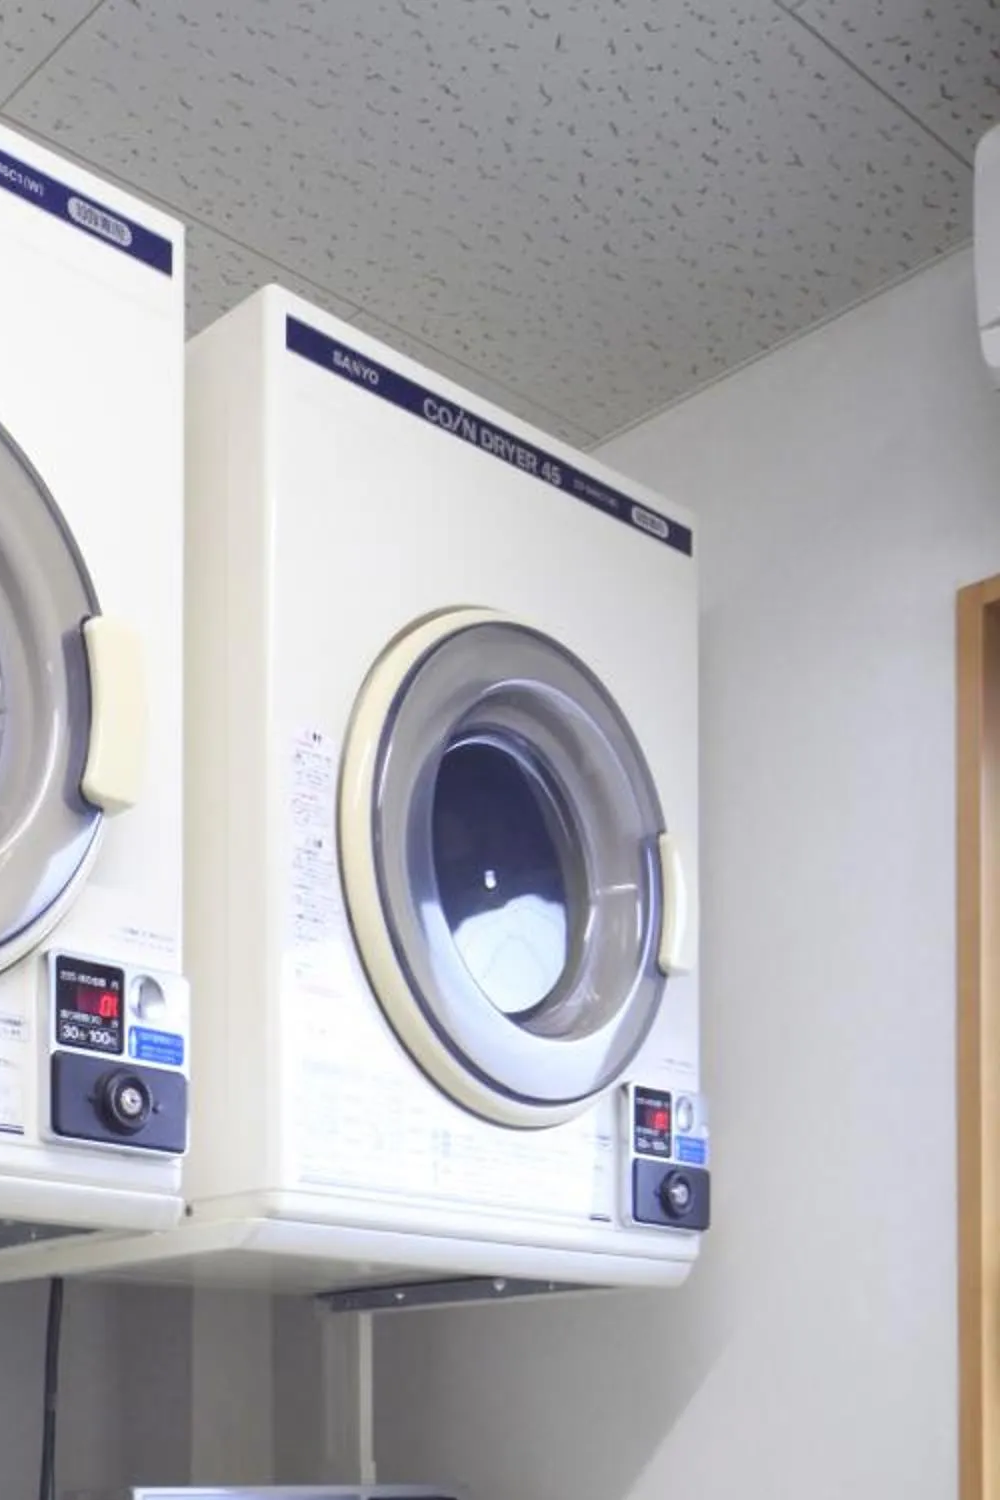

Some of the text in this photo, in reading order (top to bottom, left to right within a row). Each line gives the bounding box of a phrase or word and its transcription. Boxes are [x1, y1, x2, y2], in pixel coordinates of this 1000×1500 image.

[333, 350, 380, 386] SANYO
[480, 427, 538, 475] DRYER
[541, 460, 563, 487] 45
